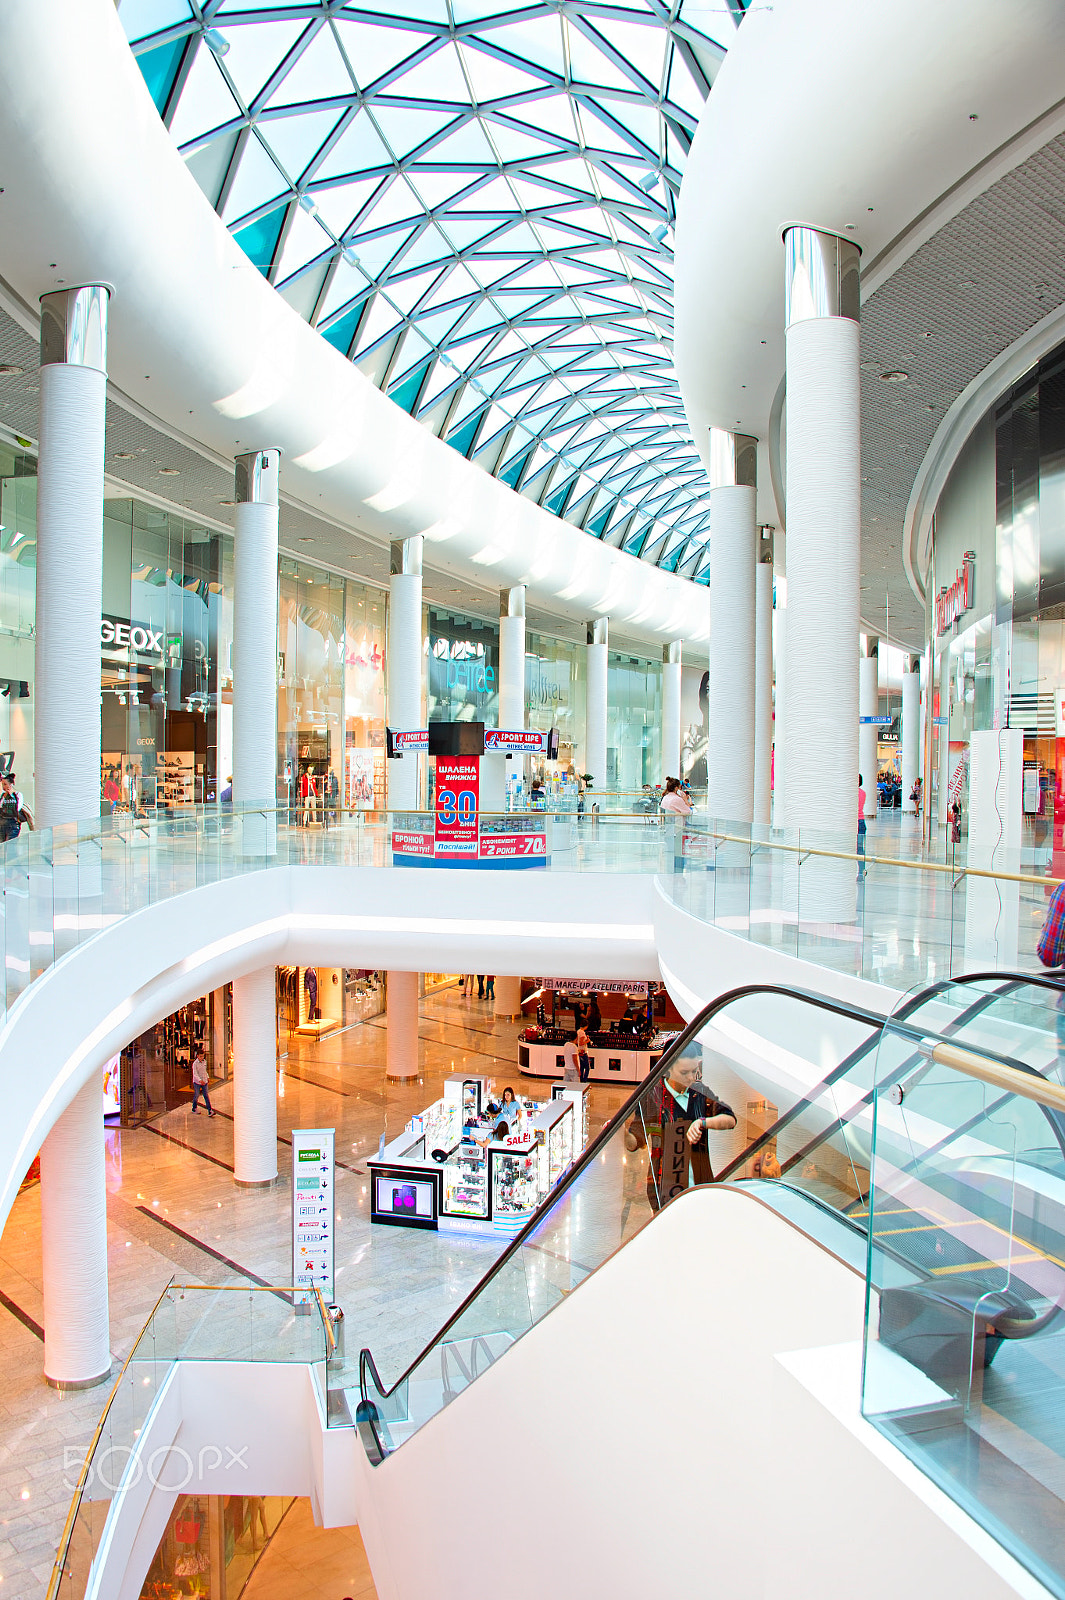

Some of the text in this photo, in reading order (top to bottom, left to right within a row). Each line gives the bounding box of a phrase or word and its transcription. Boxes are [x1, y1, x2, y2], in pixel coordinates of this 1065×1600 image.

[100, 619, 163, 652] GEOX
[136, 737, 155, 746] GEOX
[405, 733, 420, 741] SPORT
[501, 733, 539, 742] SPORT LIFE
[438, 790, 476, 825] 30
[395, 834, 424, 844] БРОНЮЙ
[487, 845, 495, 855] 2
[555, 980, 645, 993] MAKE-UP ATELIER PARIS
[507, 1132, 531, 1146] SALE!
